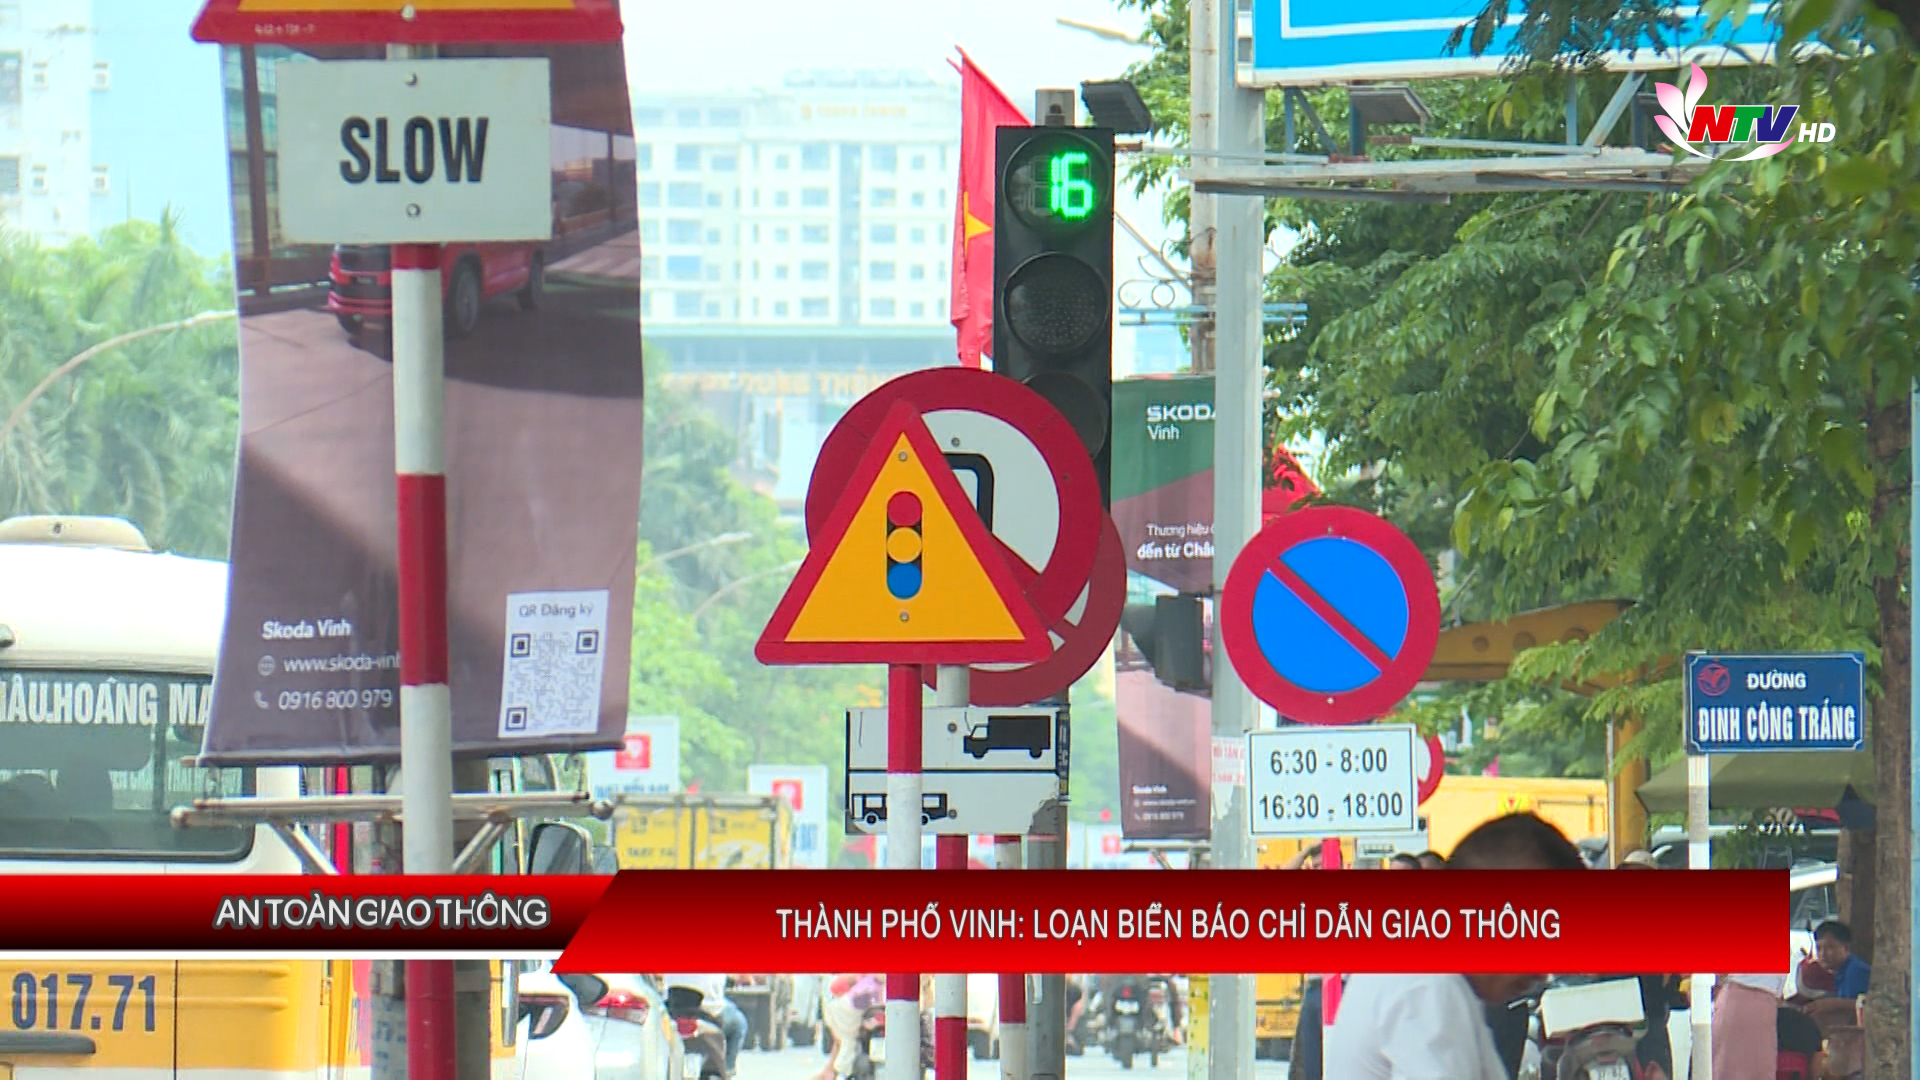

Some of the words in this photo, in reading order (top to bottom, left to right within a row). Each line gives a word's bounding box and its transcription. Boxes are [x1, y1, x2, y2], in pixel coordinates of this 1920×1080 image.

[339, 115, 489, 184] SLOW
[1051, 152, 1092, 216] 16
[1147, 424, 1180, 440] Vinh
[1137, 542, 1163, 559] đến
[1165, 543, 1181, 558] từ
[519, 604, 537, 617] QR
[262, 620, 315, 640] Skoda
[317, 619, 352, 637] Vinh
[1747, 668, 1807, 690] ĐƯỜNG
[278, 691, 323, 710] 0916
[325, 689, 358, 709] 800
[361, 689, 392, 708] 979
[1699, 707, 1741, 742] ĐINH
[1746, 700, 1794, 742] CÔNG
[1798, 697, 1856, 741] TRÁNG
[1270, 748, 1318, 775] 6:30
[1341, 747, 1388, 773] 8:00
[1259, 792, 1319, 819] 16:30
[1343, 791, 1403, 817] 18:00
[12, 972, 156, 1032] 017.71
